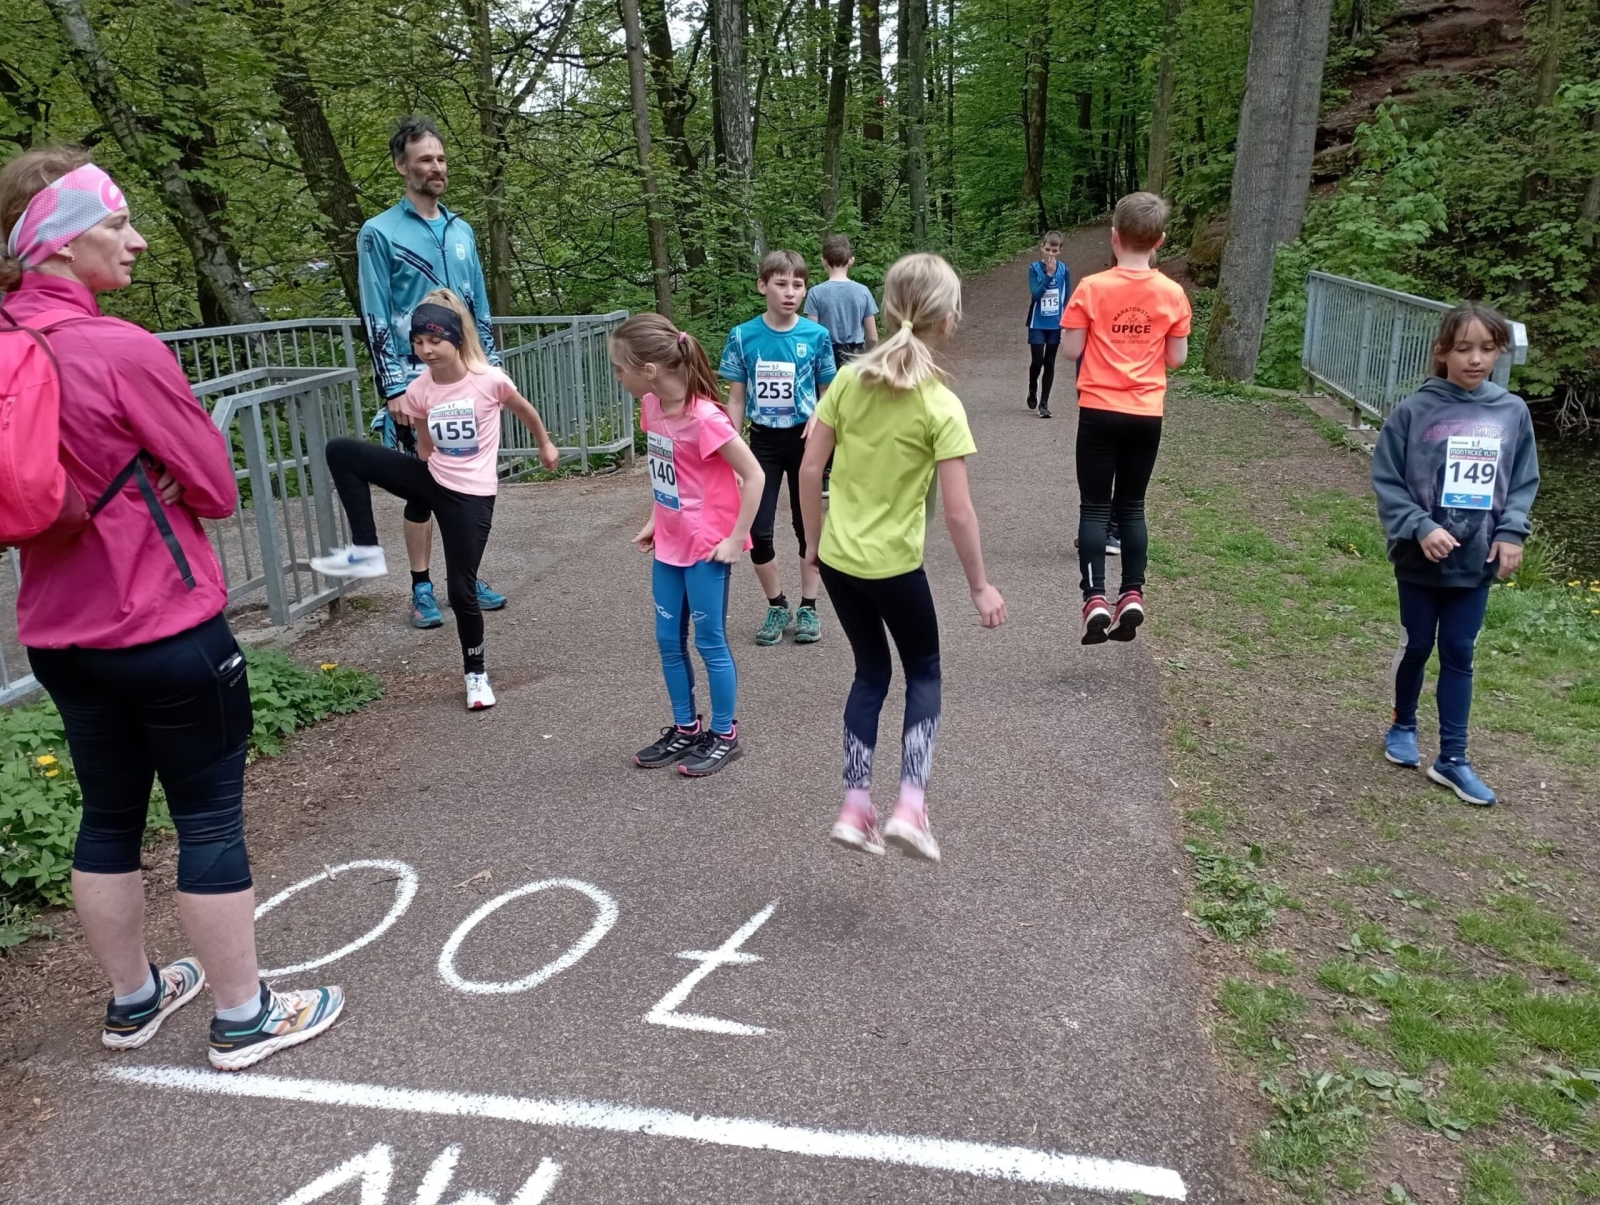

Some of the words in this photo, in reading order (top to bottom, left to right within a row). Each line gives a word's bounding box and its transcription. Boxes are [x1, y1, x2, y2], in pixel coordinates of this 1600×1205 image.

[1041, 298, 1059, 307] 115
[757, 381, 793, 399] 253
[431, 420, 476, 441] 155
[649, 458, 676, 486] 140
[1449, 461, 1496, 485] 149
